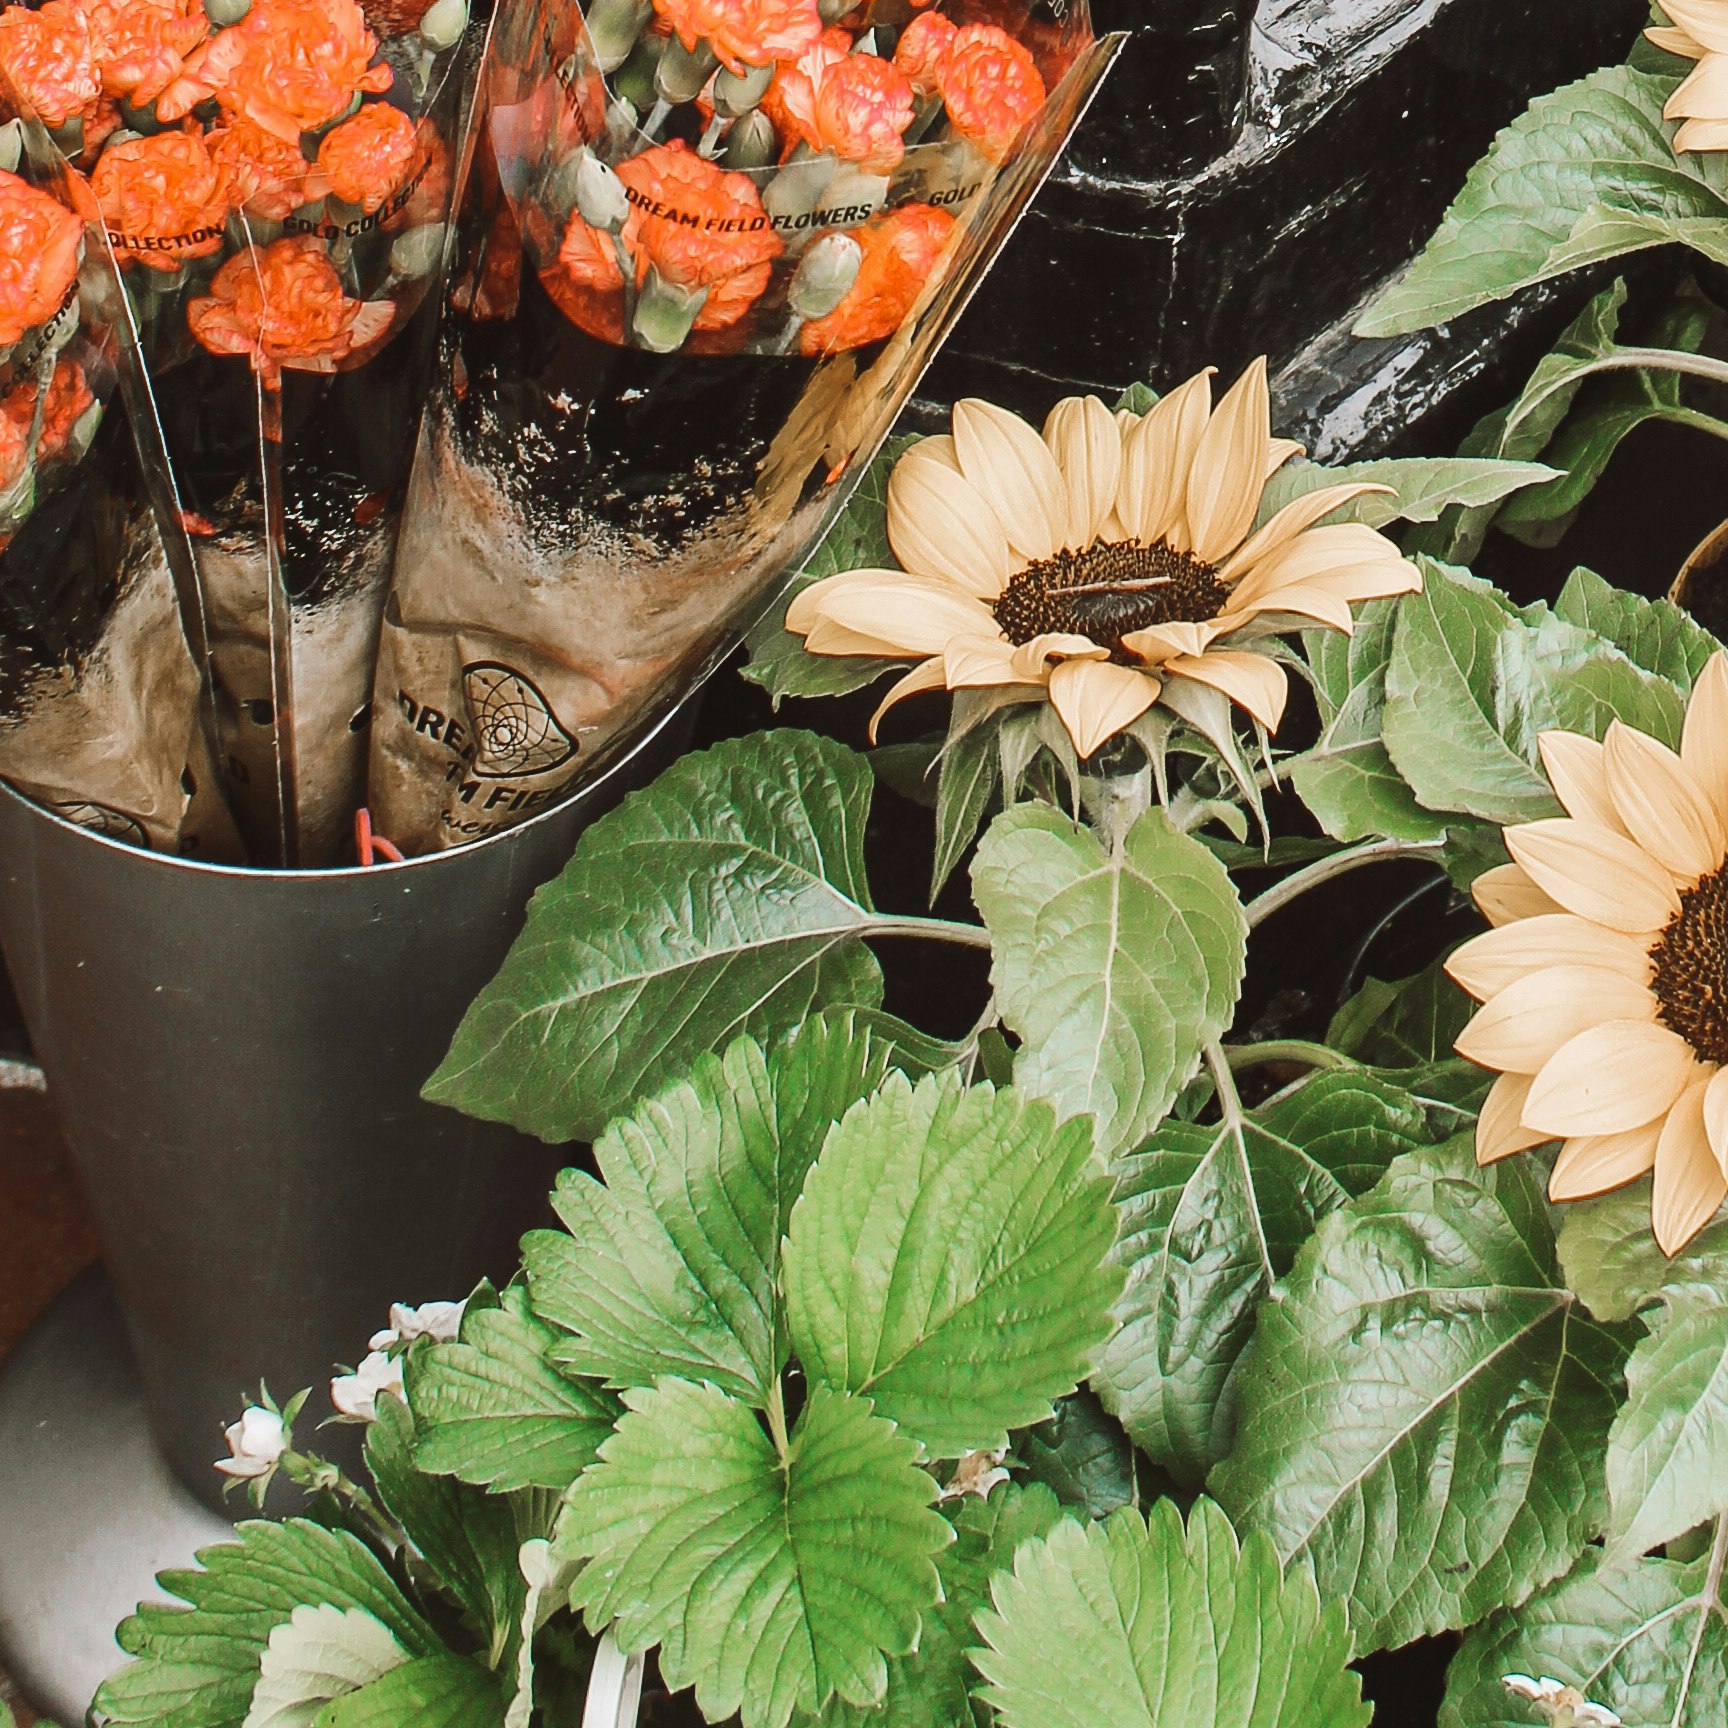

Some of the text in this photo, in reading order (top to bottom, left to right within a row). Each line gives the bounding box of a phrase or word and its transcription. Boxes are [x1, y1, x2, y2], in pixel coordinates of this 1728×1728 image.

[623, 184, 700, 231] DREAM
[703, 214, 766, 234] FIELD
[769, 202, 873, 232] FLOWERS
[104, 222, 226, 253] OLLECTION
[282, 215, 340, 240] GOLD
